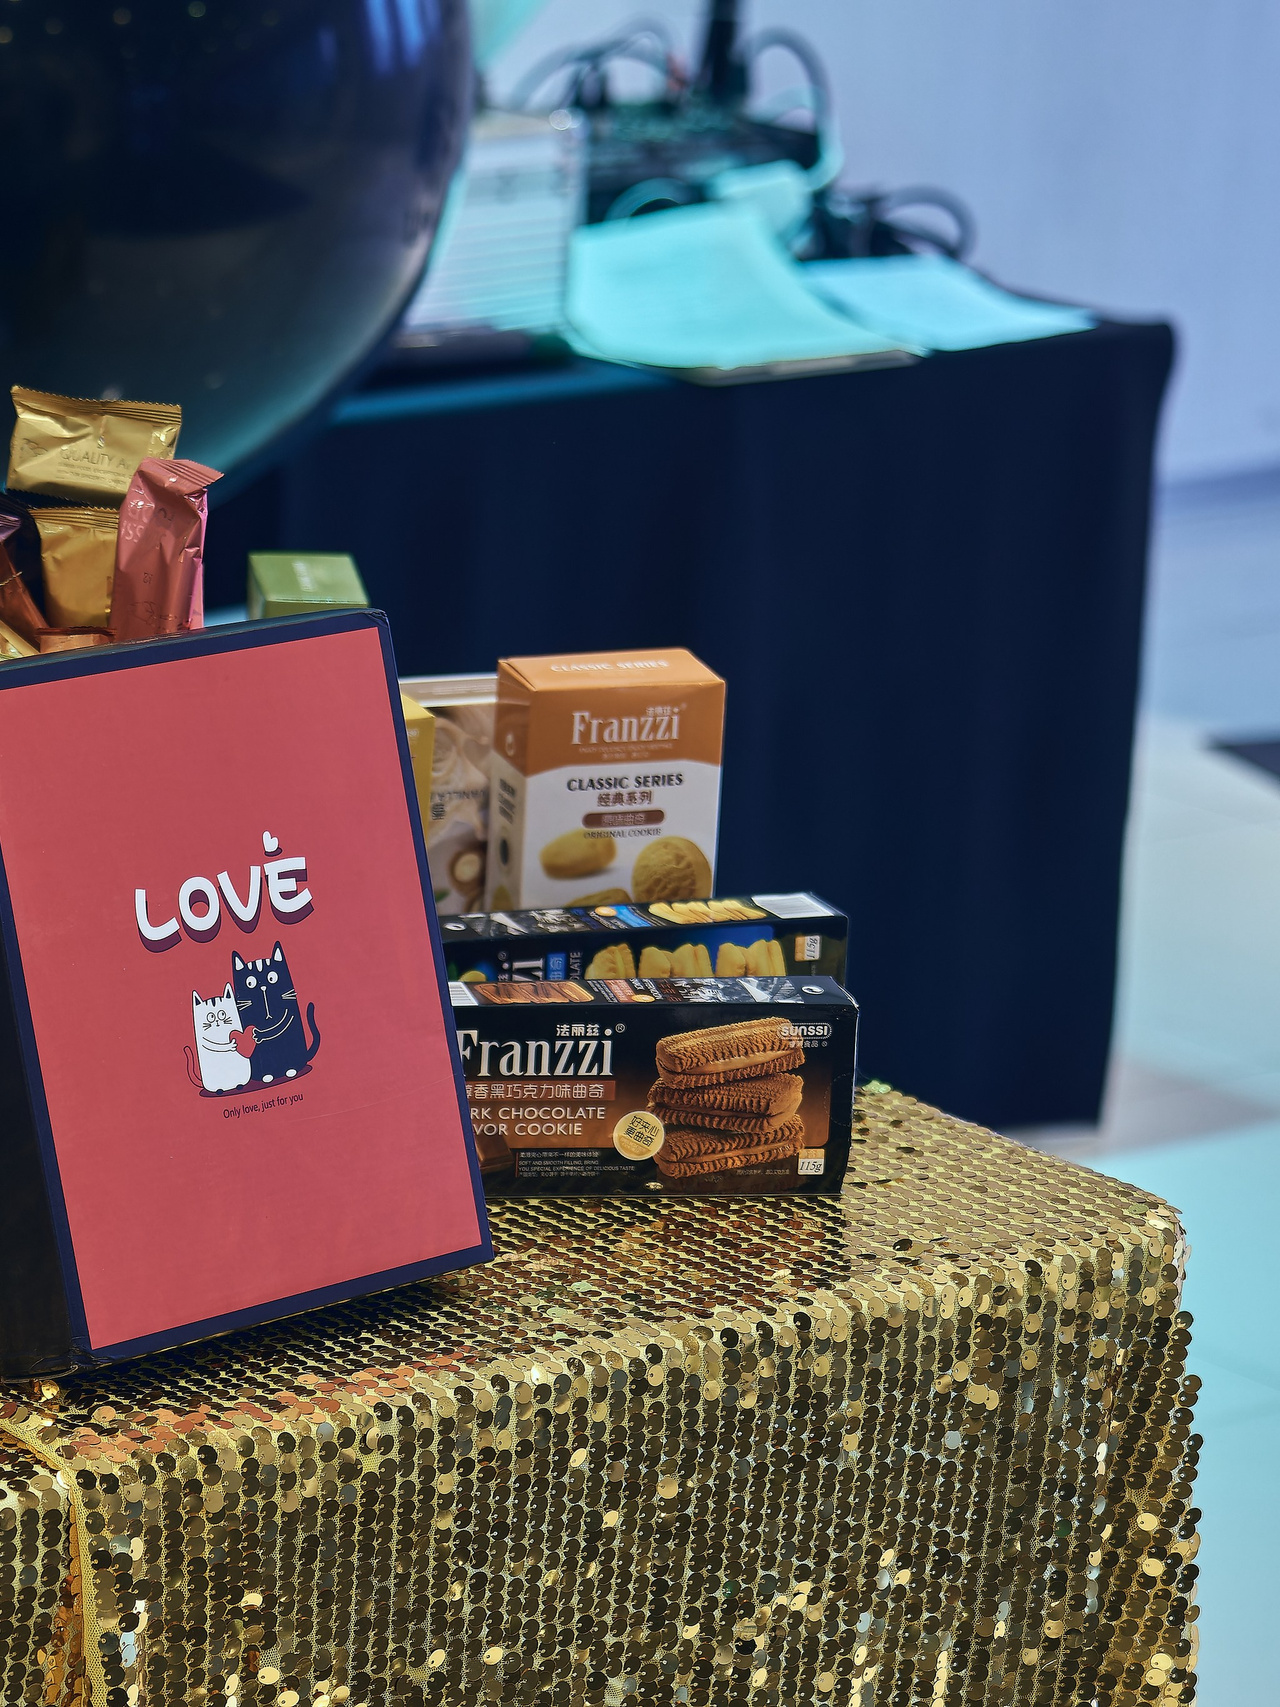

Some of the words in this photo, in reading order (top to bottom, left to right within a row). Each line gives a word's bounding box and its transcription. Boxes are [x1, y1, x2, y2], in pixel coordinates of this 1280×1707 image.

[572, 708, 680, 745] Franzzi
[567, 777, 629, 792] CLASSIC
[634, 773, 684, 789] SERIES
[135, 856, 314, 952] LOVE
[456, 1025, 613, 1077] Franzzi
[223, 1107, 241, 1119] Only
[242, 1104, 260, 1114] love,
[261, 1099, 275, 1112] just
[277, 1096, 288, 1106] for
[288, 1093, 304, 1105] you
[470, 1107, 492, 1120] RK
[498, 1106, 606, 1120] CHOCOLATE
[472, 1123, 509, 1136] VOR
[514, 1122, 583, 1136] COOKIE
[799, 1162, 822, 1172] 115g
